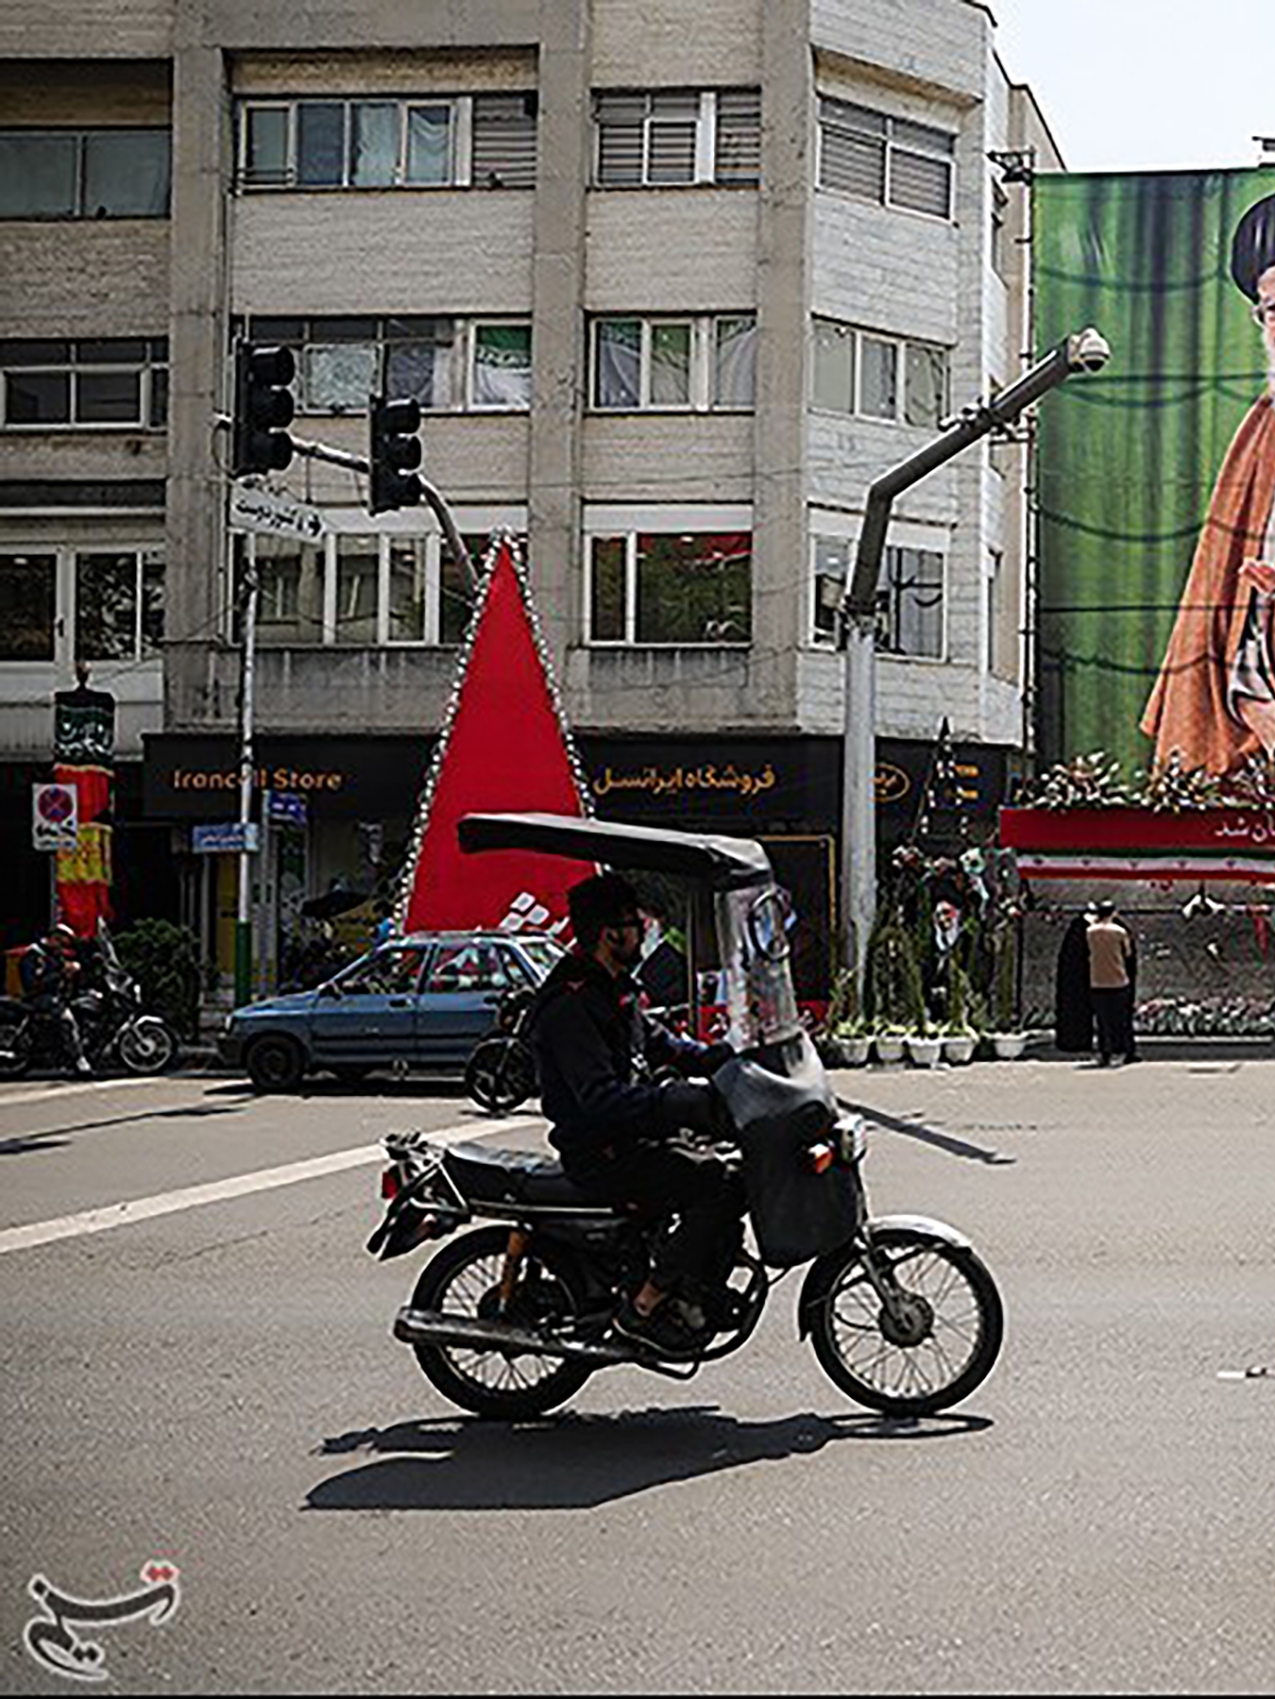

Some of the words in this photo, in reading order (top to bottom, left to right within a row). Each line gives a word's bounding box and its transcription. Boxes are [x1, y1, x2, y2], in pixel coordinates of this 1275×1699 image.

[173, 769, 267, 789] Irancll
[272, 768, 342, 790] Store
[593, 767, 682, 796] ایرانسل
[685, 763, 776, 796] فروشگاه
[1214, 817, 1249, 836] شد
